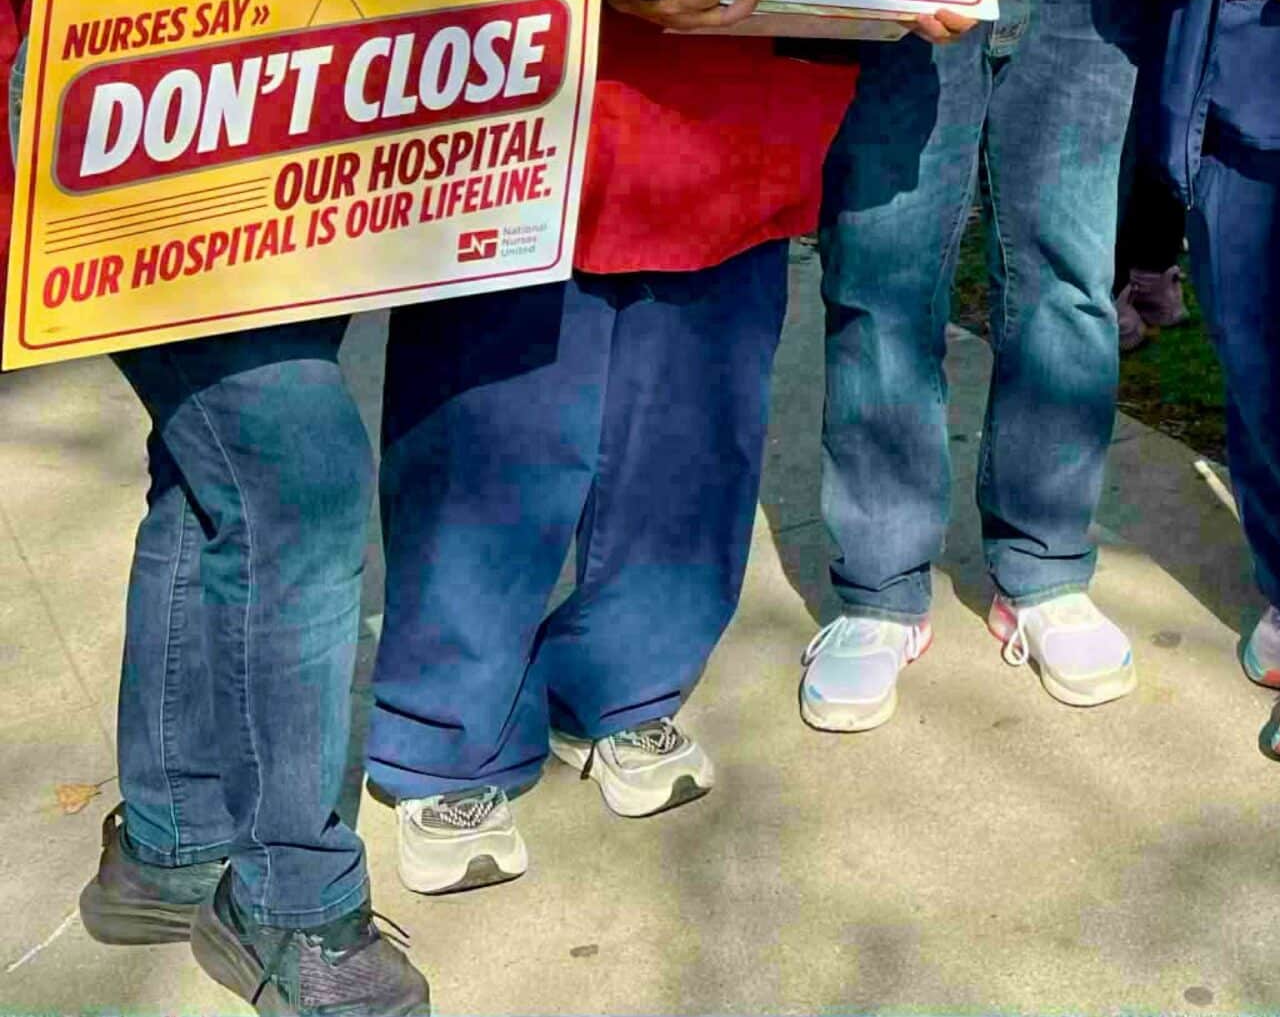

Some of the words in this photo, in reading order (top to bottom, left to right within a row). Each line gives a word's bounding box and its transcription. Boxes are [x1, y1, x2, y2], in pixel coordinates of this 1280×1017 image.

[62, 6, 188, 60] NURSES
[80, 46, 334, 177] DON'T
[344, 14, 551, 123] CLOSE
[274, 157, 356, 211] OUR
[367, 117, 557, 191] HOSPITAL.
[43, 256, 122, 308] OUR
[131, 223, 296, 288] HOSPITAL
[306, 206, 337, 245] IS
[345, 188, 412, 234] OUR
[419, 164, 552, 222] LIFELINE.
[501, 245, 535, 257] United
